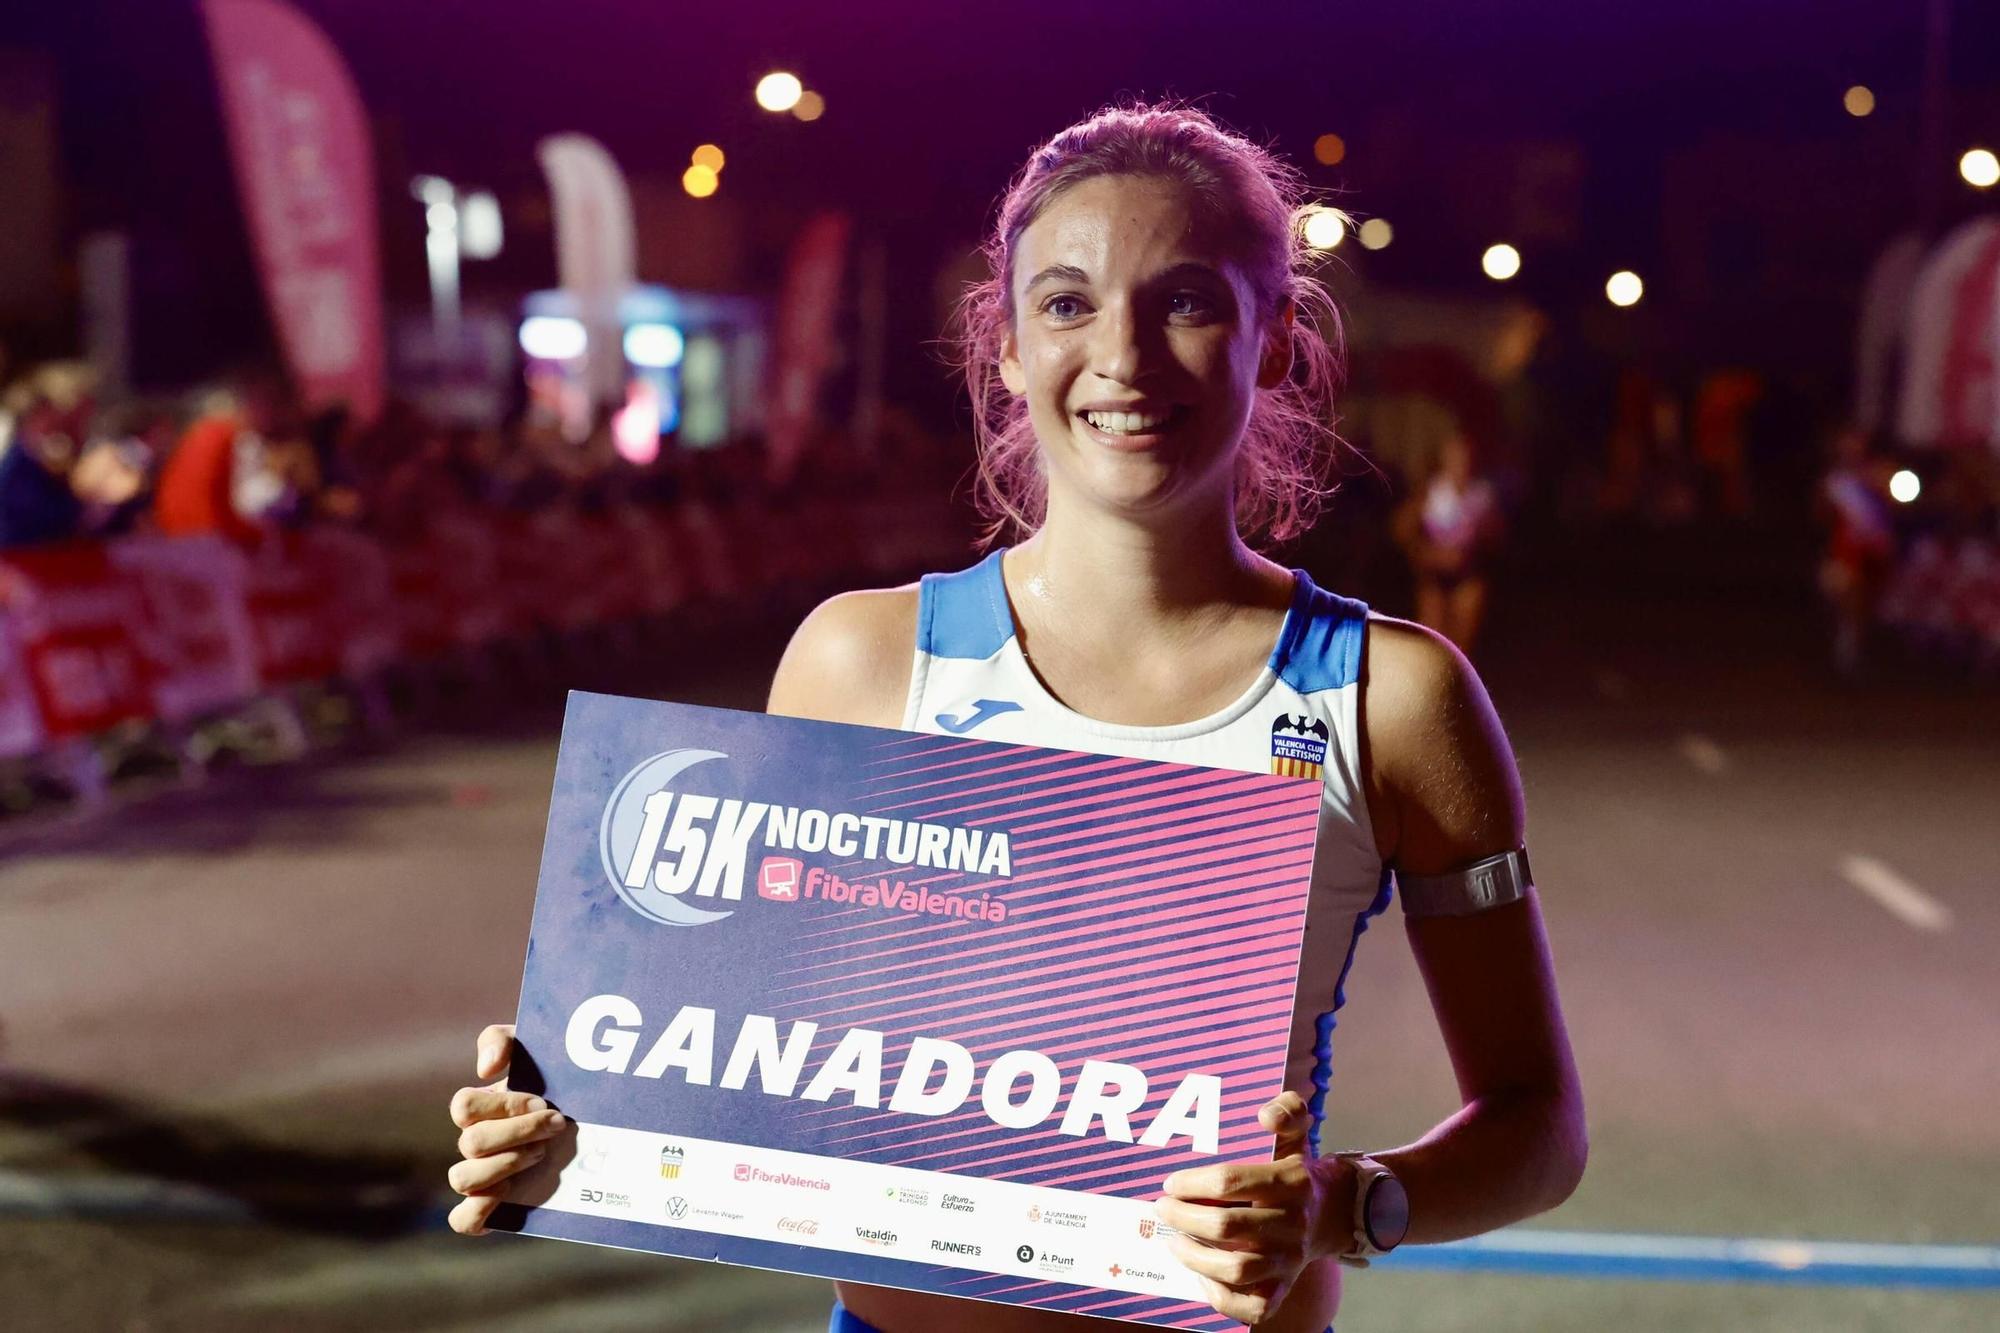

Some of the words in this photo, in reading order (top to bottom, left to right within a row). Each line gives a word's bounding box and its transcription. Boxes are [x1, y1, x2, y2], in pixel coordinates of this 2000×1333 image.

[1274, 738, 1305, 751] VALENCIA
[1307, 743, 1324, 753] CLUB
[1274, 747, 1322, 762] ATLETISMO
[624, 790, 769, 901] 15K
[764, 804, 1013, 877] NOCTURNA
[804, 870, 1007, 922] FibraValencia
[563, 993, 1222, 1155] GANADORA
[752, 1167, 831, 1191] FibraValencia
[899, 1198, 928, 1207] ALFONSO
[900, 1191, 929, 1201] TRINIDAD
[941, 1201, 975, 1213] Esfuerzo
[1044, 1210, 1087, 1222] AJUNTAMENT
[856, 1226, 898, 1242] Vitaldin
[1051, 1254, 1075, 1266] Punt
[1125, 1268, 1145, 1278] Cruz
[1146, 1271, 1165, 1281] Roja
